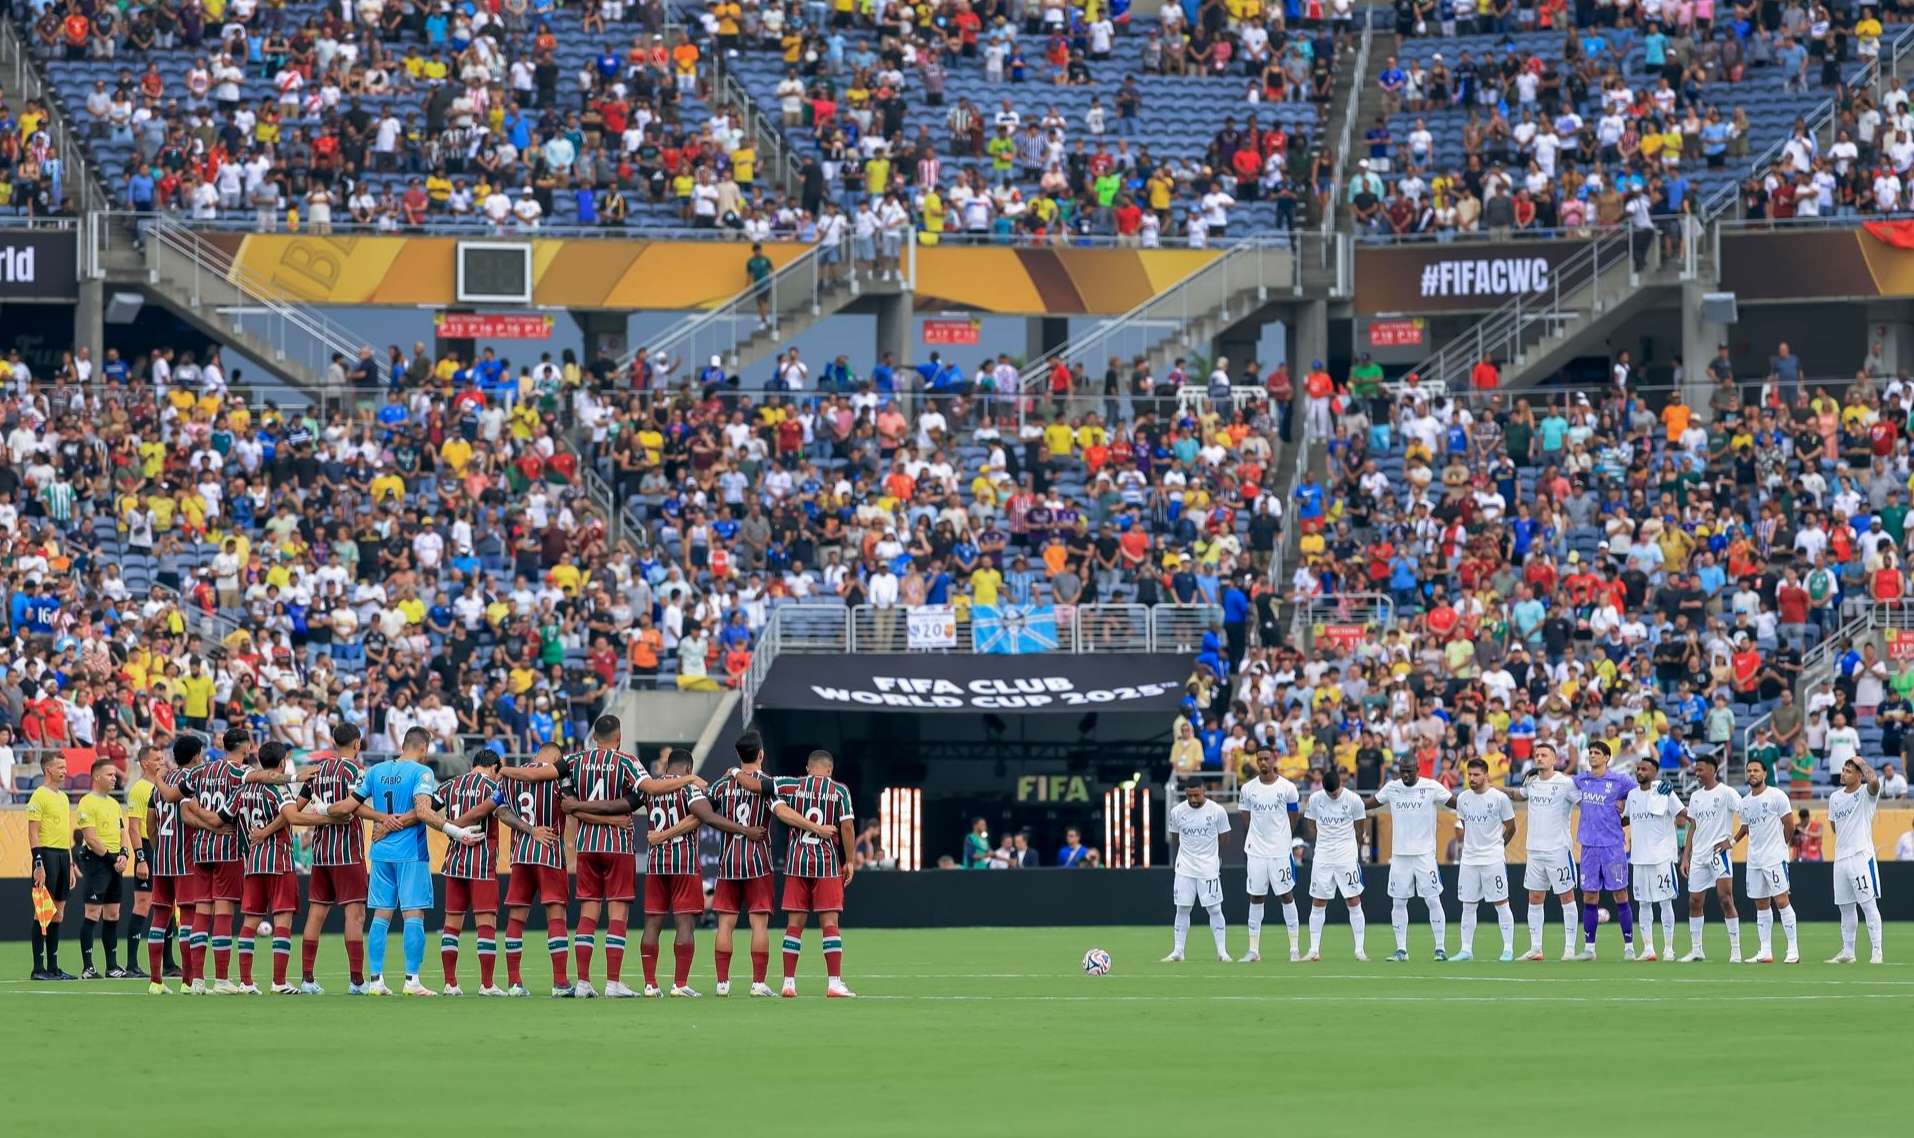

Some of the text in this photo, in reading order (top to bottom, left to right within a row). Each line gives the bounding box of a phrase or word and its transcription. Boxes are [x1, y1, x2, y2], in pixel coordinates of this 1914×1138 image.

[1421, 257, 1549, 297] #FIFACWC
[38, 606, 52, 624] 16
[872, 676, 1074, 695] FIFA CLUB
[810, 685, 964, 708] WORLD
[971, 693, 1053, 708] CUP
[587, 778, 605, 801] 4
[1017, 775, 1090, 802] FIFA
[1582, 791, 1607, 802] SAVVY
[384, 790, 394, 816] 1
[517, 791, 535, 827] 3
[1396, 801, 1423, 809] SAVVY
[801, 806, 824, 845] 2
[1182, 827, 1209, 836] SAVVY
[1278, 866, 1292, 883] 28
[1345, 870, 1359, 886] 20
[1429, 870, 1438, 885] 3
[1495, 874, 1504, 890] 8
[1556, 865, 1571, 882] 22
[1657, 873, 1670, 889] 24
[1771, 869, 1780, 884] 6
[1205, 878, 1220, 894] 77
[1855, 874, 1869, 891] 11
